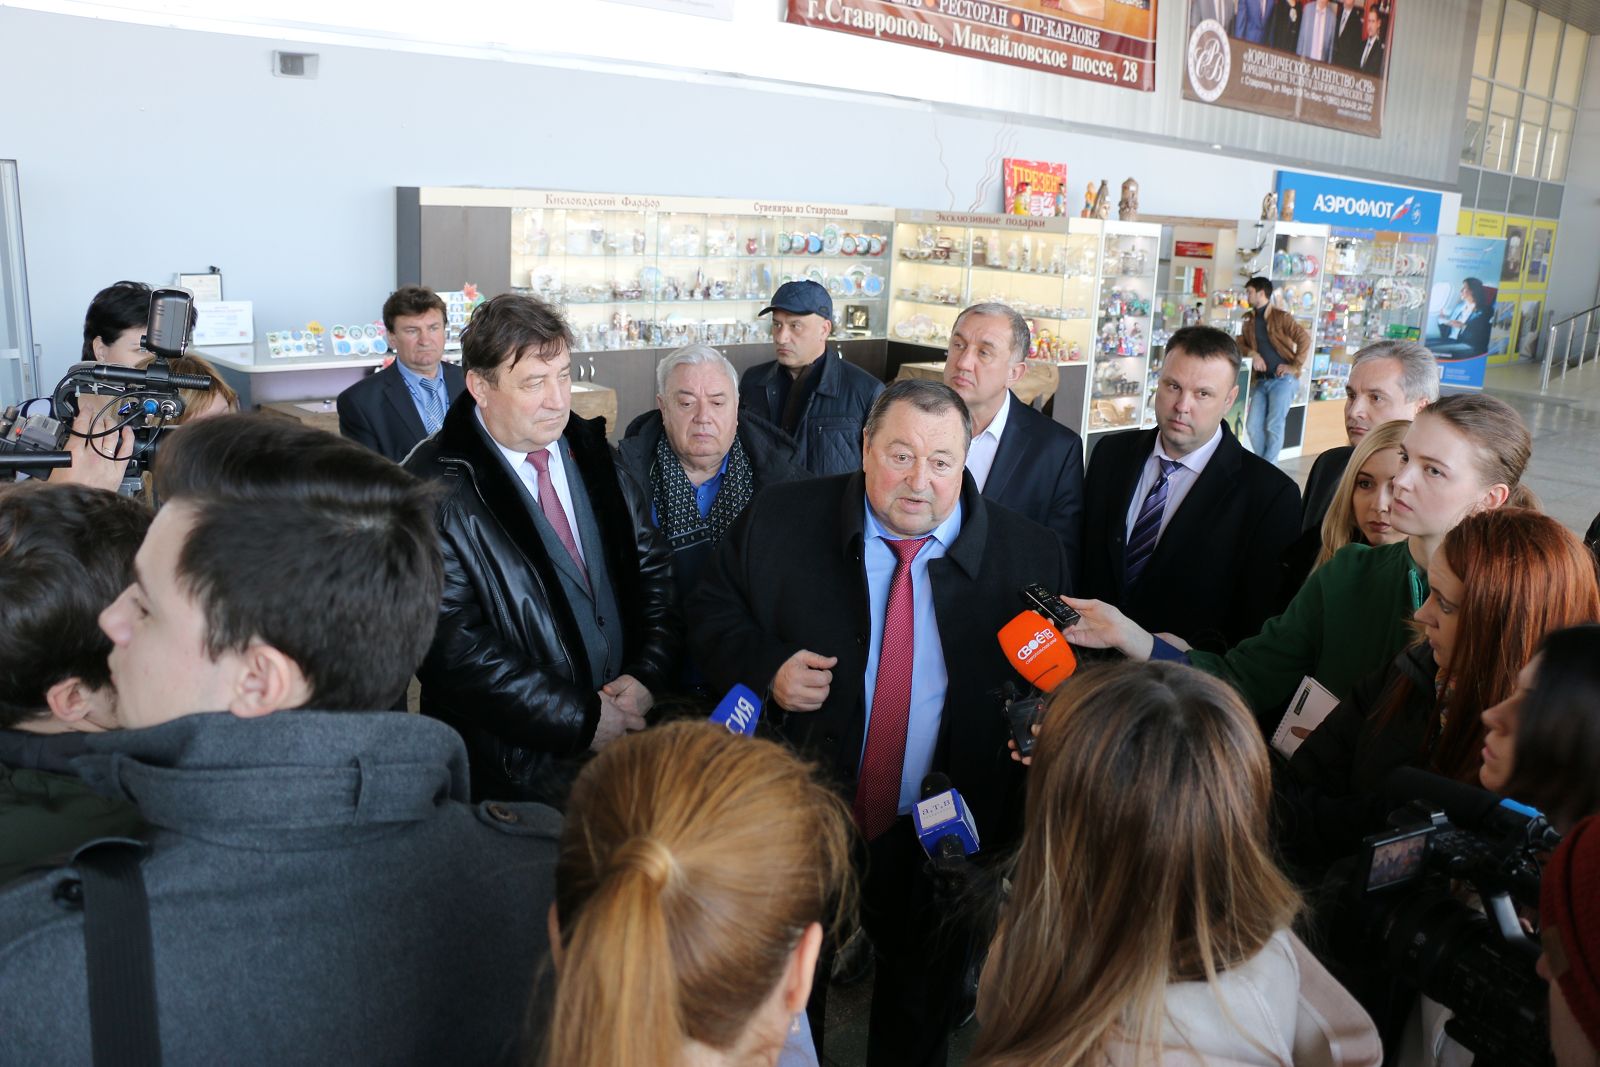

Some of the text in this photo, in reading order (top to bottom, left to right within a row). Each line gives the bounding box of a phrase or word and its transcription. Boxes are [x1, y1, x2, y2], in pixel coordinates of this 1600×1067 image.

[938, 0, 1100, 48] РЕСТОРАН VIP-КАРАОКЕ
[952, 23, 1067, 68] Михайловское
[1072, 55, 1117, 82] шоссе,
[1123, 60, 1138, 83] 28
[753, 202, 793, 215] Сувениры
[806, 204, 848, 217] Ставрополя
[1313, 194, 1394, 218] АЭРОФЛОТ
[936, 211, 1046, 230] Эксклюзивные подарки
